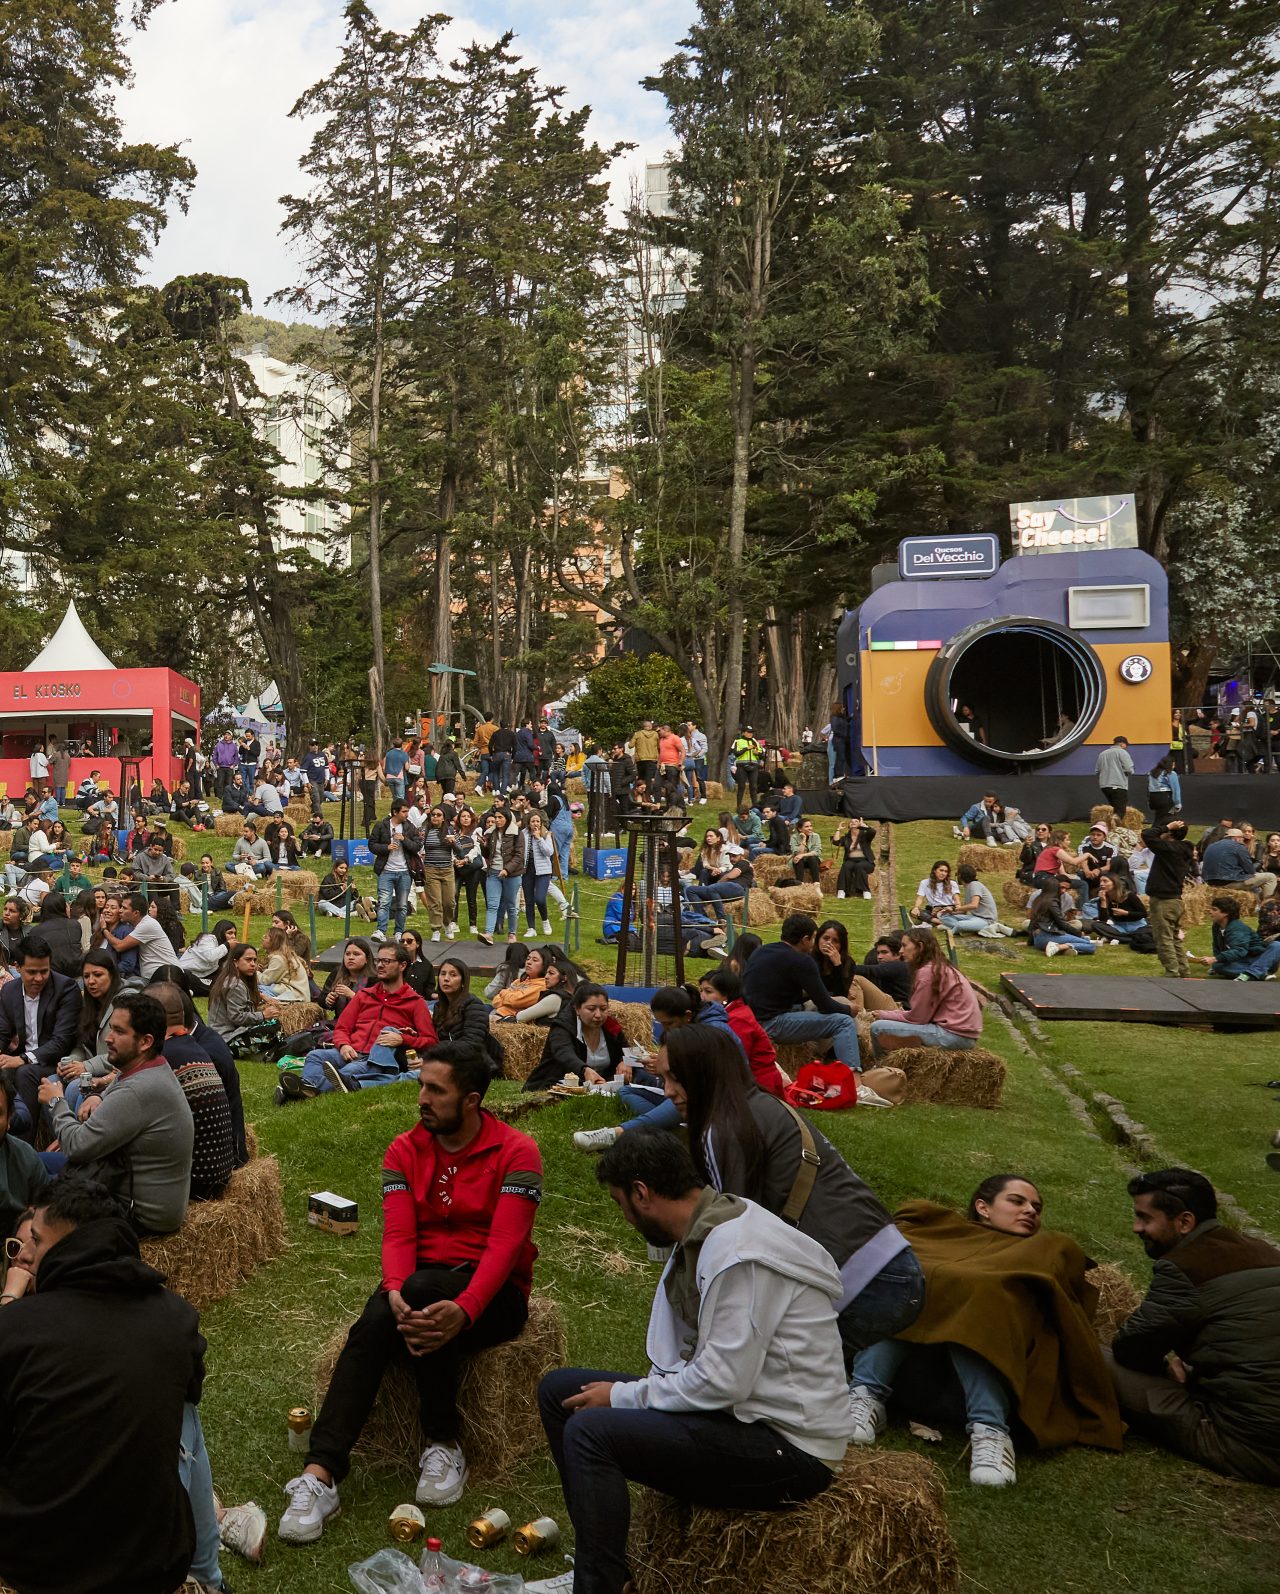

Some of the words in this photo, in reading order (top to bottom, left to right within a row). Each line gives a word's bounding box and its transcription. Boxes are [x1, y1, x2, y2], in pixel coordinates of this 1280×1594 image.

[1017, 509, 1057, 532] Say
[1021, 522, 1107, 548] Cheese!
[913, 553, 934, 563] Del
[936, 551, 984, 562] Vecchio
[13, 685, 28, 699] EL
[35, 683, 81, 698] KIOSKO
[312, 756, 326, 767] 95
